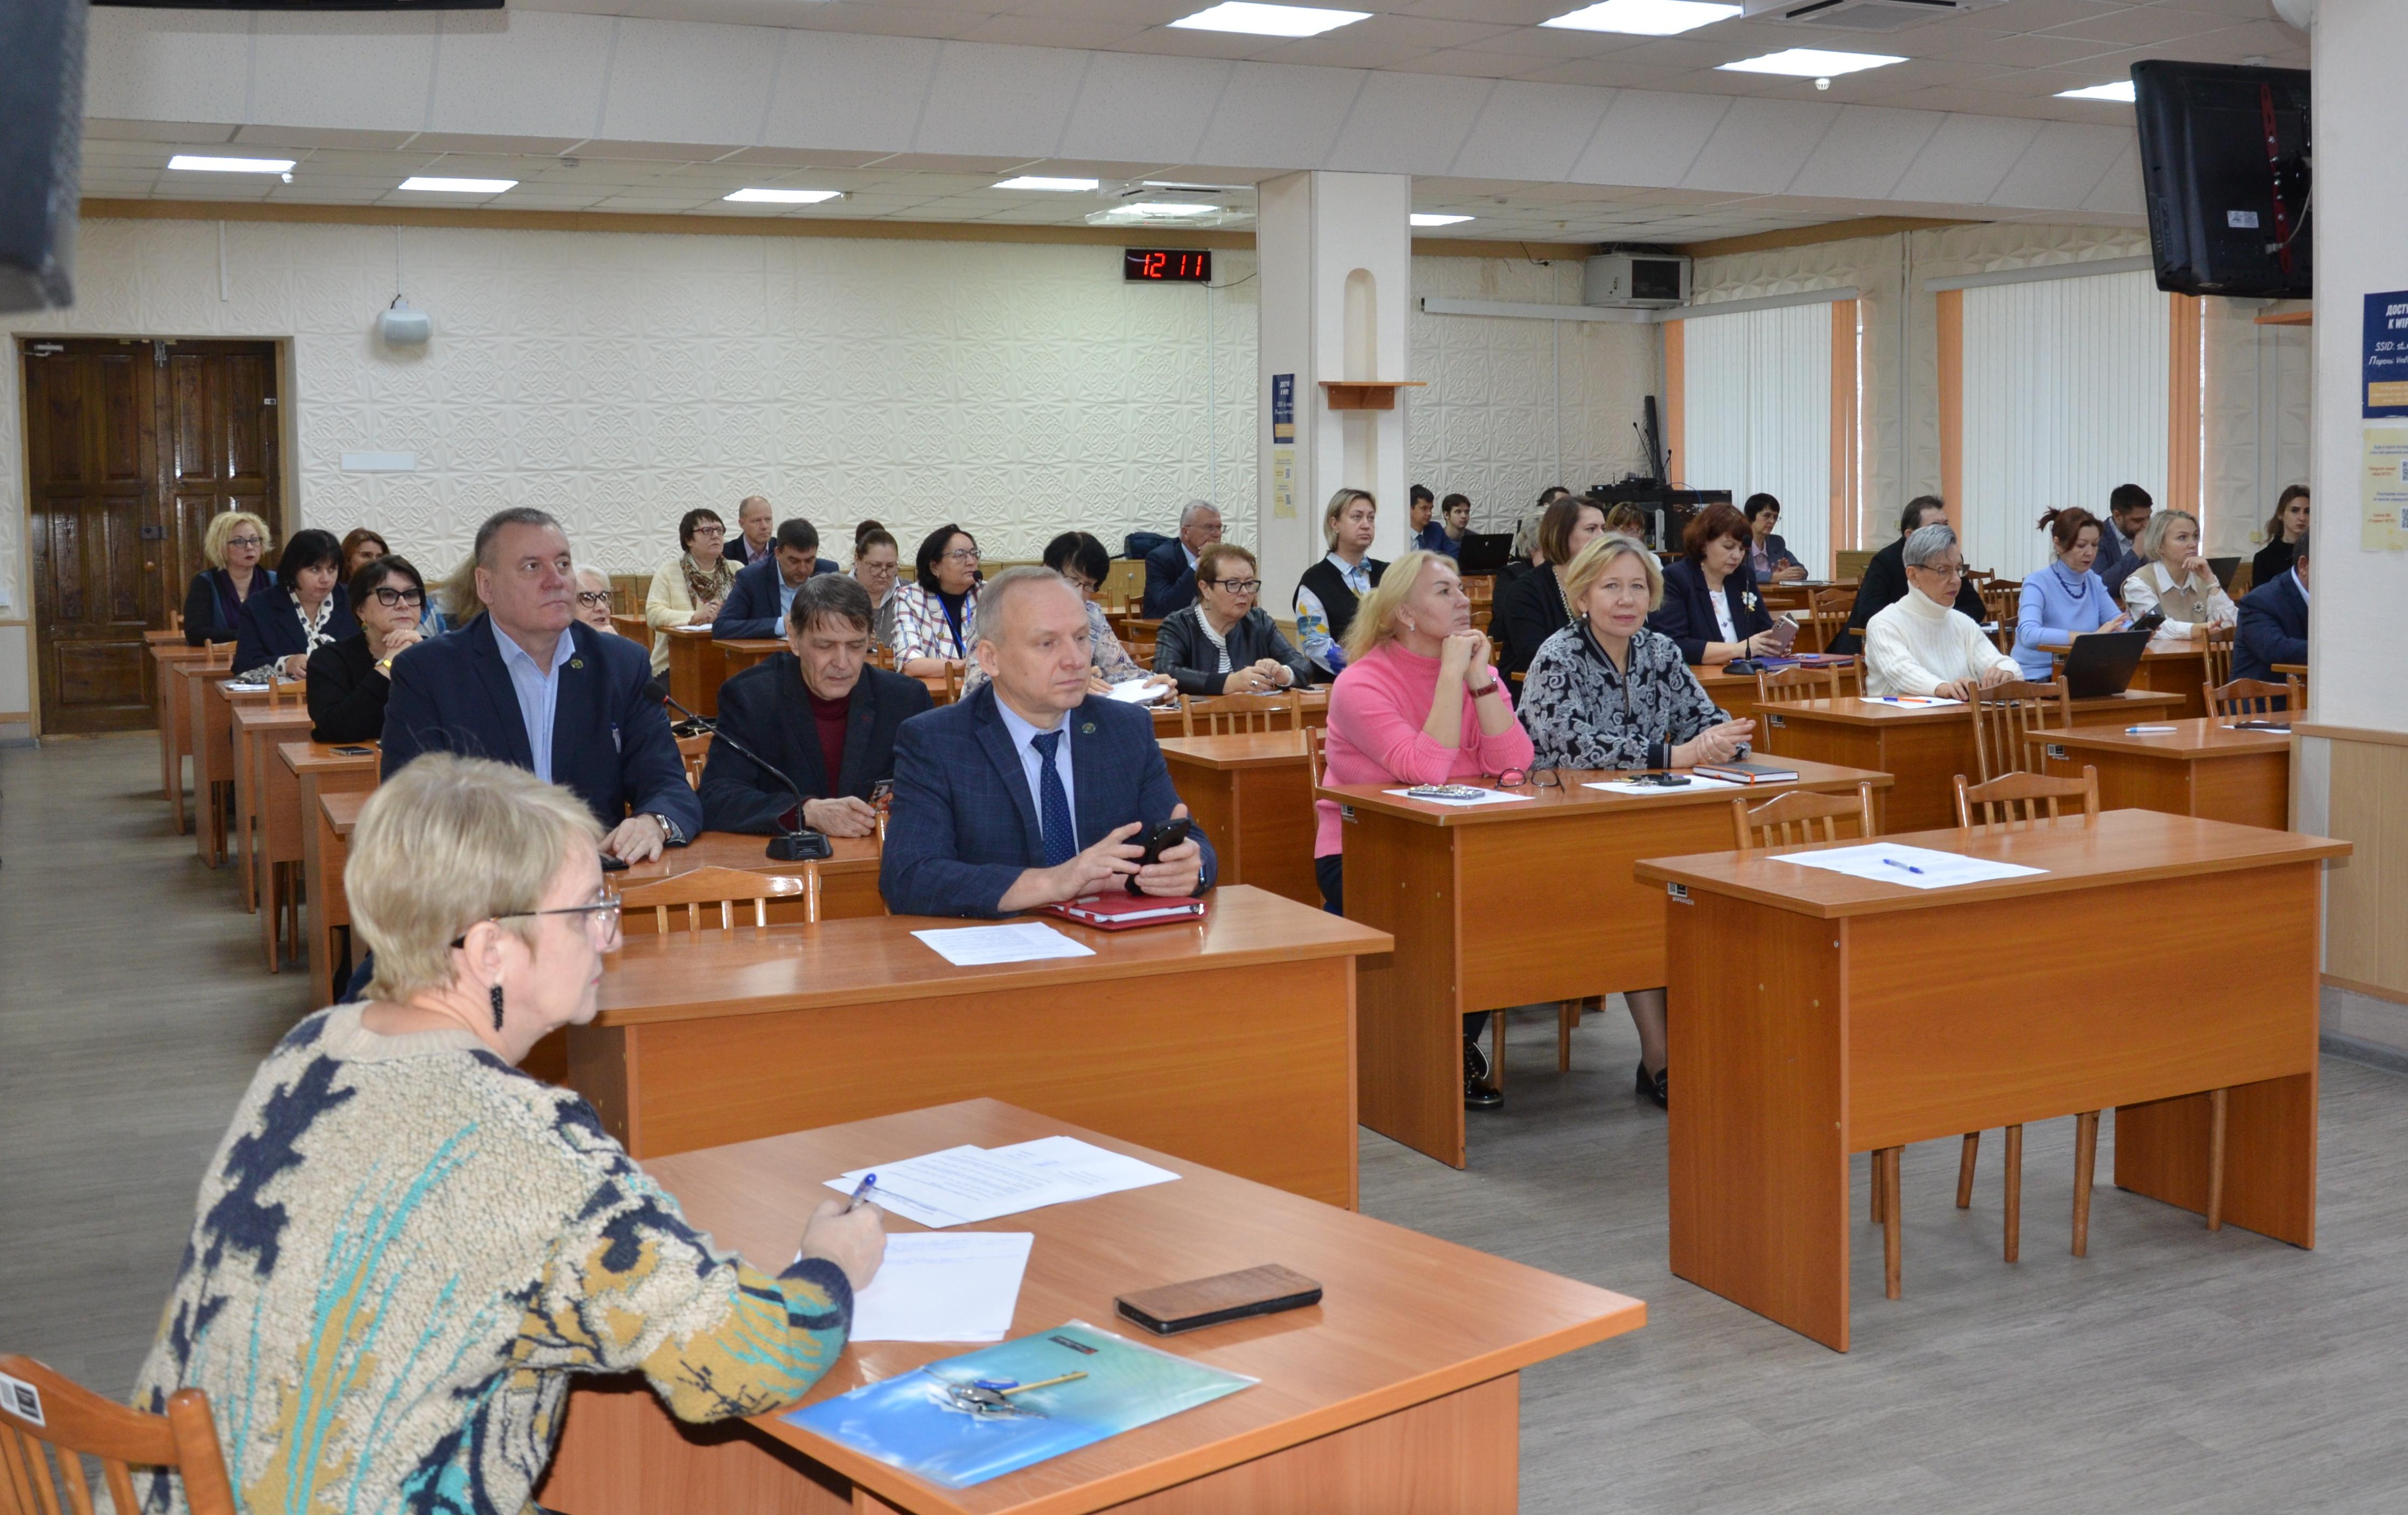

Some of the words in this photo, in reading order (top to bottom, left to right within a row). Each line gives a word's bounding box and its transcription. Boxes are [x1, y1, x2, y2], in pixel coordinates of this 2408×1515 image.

[1143, 252, 1166, 278] 12
[1180, 254, 1203, 276] 11
[2375, 341, 2395, 352] SSID:
